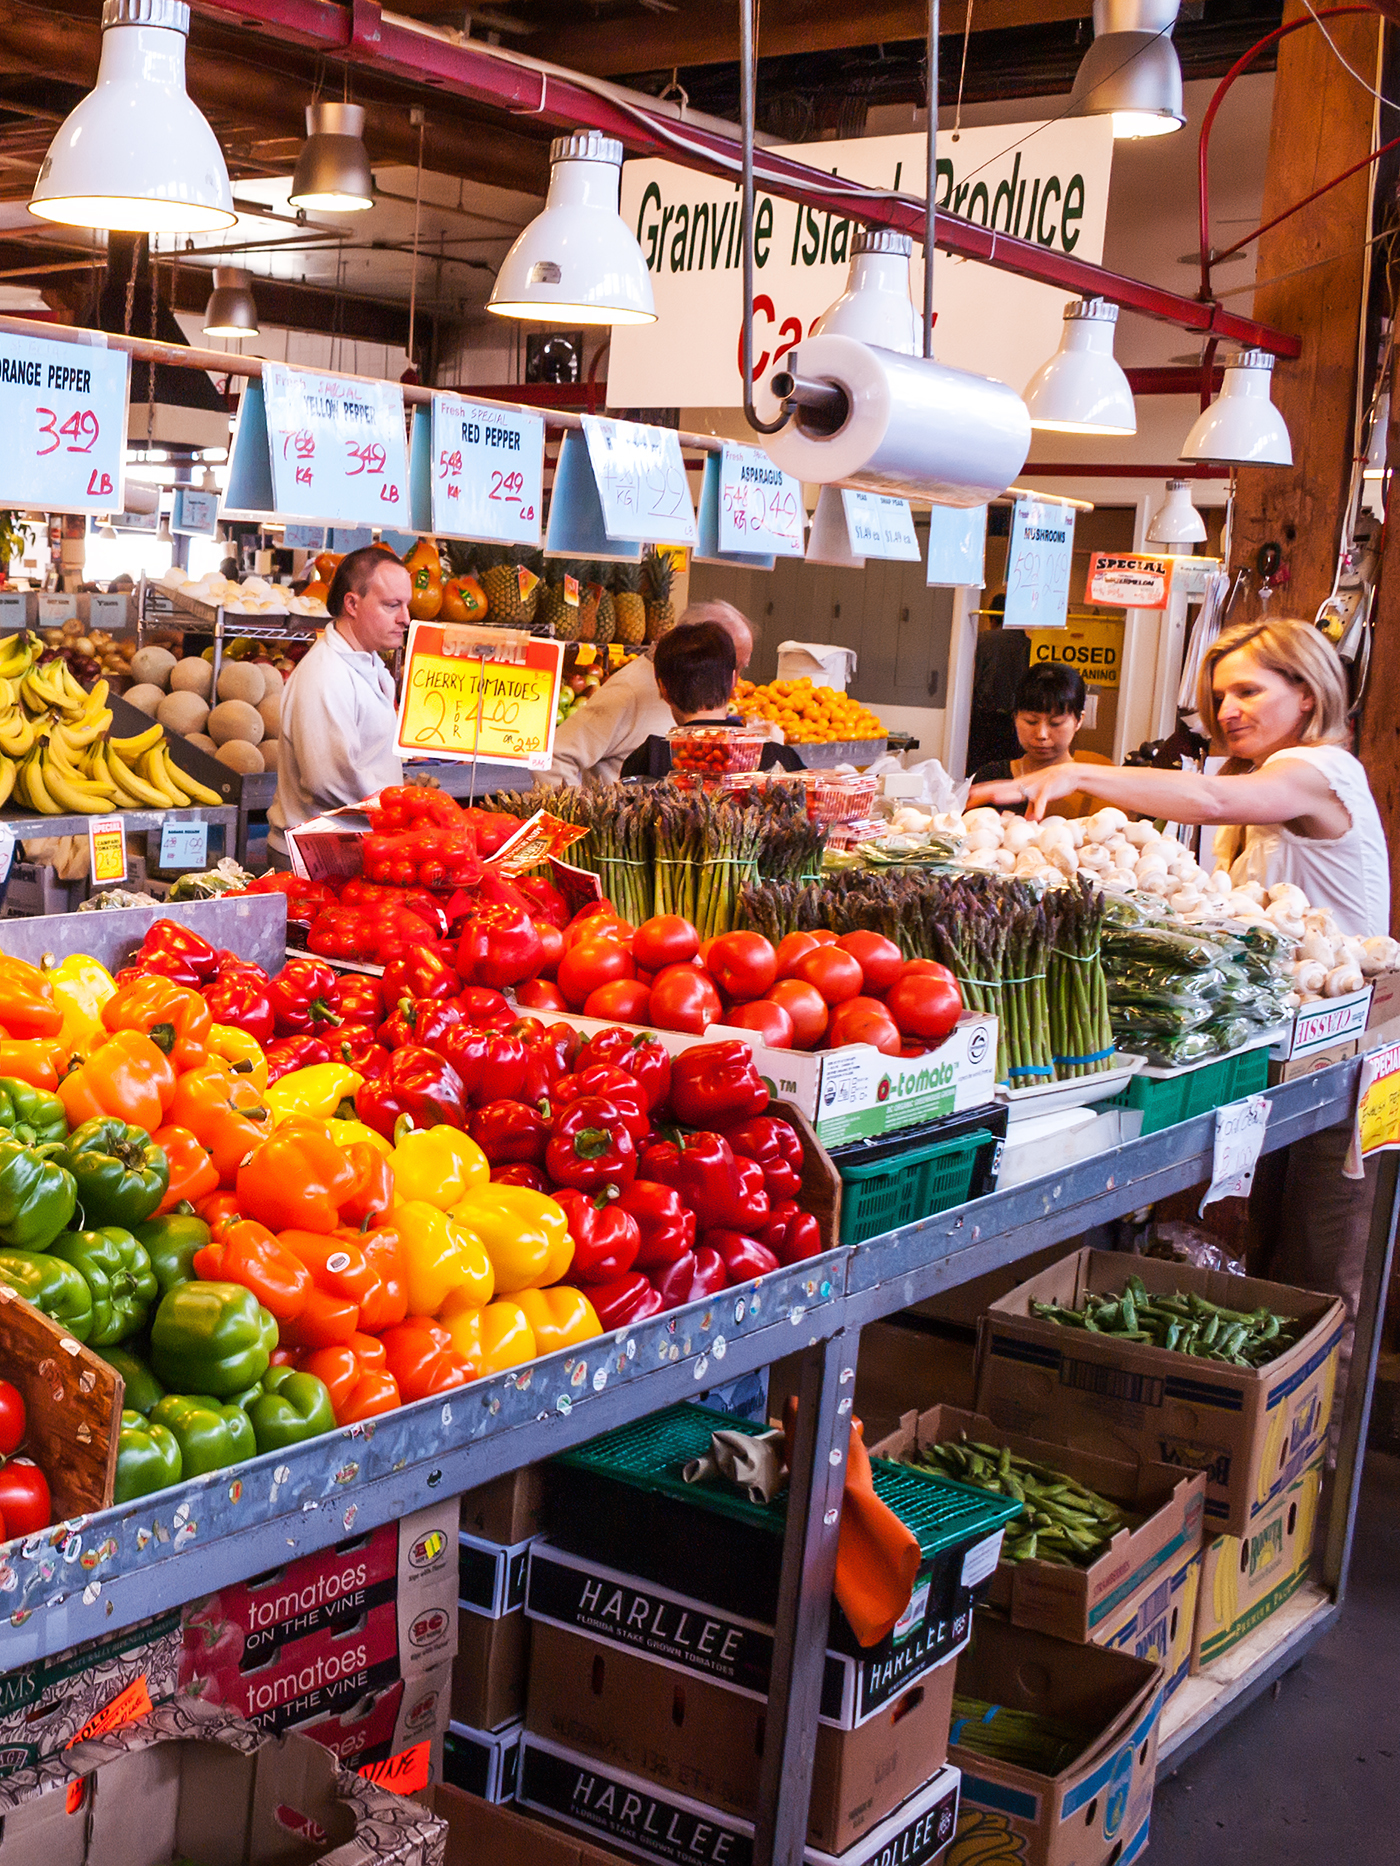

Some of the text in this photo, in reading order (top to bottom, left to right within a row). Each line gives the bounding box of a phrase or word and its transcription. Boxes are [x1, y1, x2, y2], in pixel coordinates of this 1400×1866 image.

[638, 181, 774, 273] Granvie
[47, 363, 92, 394] PEPPER
[343, 401, 377, 425] PEPPER
[441, 403, 508, 426] Fresh SPECIAL
[462, 422, 521, 451] RED PEPPER
[726, 450, 744, 461] Fresh
[87, 468, 113, 496] LB
[740, 466, 783, 486] ASPARAGUS
[380, 484, 399, 503] LB
[520, 506, 534, 520] LB
[855, 525, 911, 544] $1.49 ea $1.49 ea
[1024, 527, 1066, 543] MUSHROOMS
[1096, 558, 1166, 575] SPECIAL
[1037, 644, 1116, 664] CLOSED
[413, 668, 540, 702] CHERRY TOMATOES
[415, 690, 446, 744] 2
[453, 700, 463, 738] FOR
[92, 822, 121, 833] SPECIAL
[779, 1079, 797, 1093] TM
[248, 1562, 367, 1630] tomatoes
[246, 1590, 366, 1650] ON THE VINE
[578, 1579, 744, 1663] HARLLEE
[576, 1613, 735, 1677] FLORIDA STAKE GROWN TOMATOES
[246, 1644, 368, 1712] tomatoes
[282, 1692, 321, 1718] THE
[326, 1670, 368, 1698] VINE
[570, 1803, 608, 1827] FLORIDA
[609, 1820, 637, 1842] STAKE
[639, 1834, 674, 1857] GROWN
[573, 1772, 735, 1864] HARLLEE
